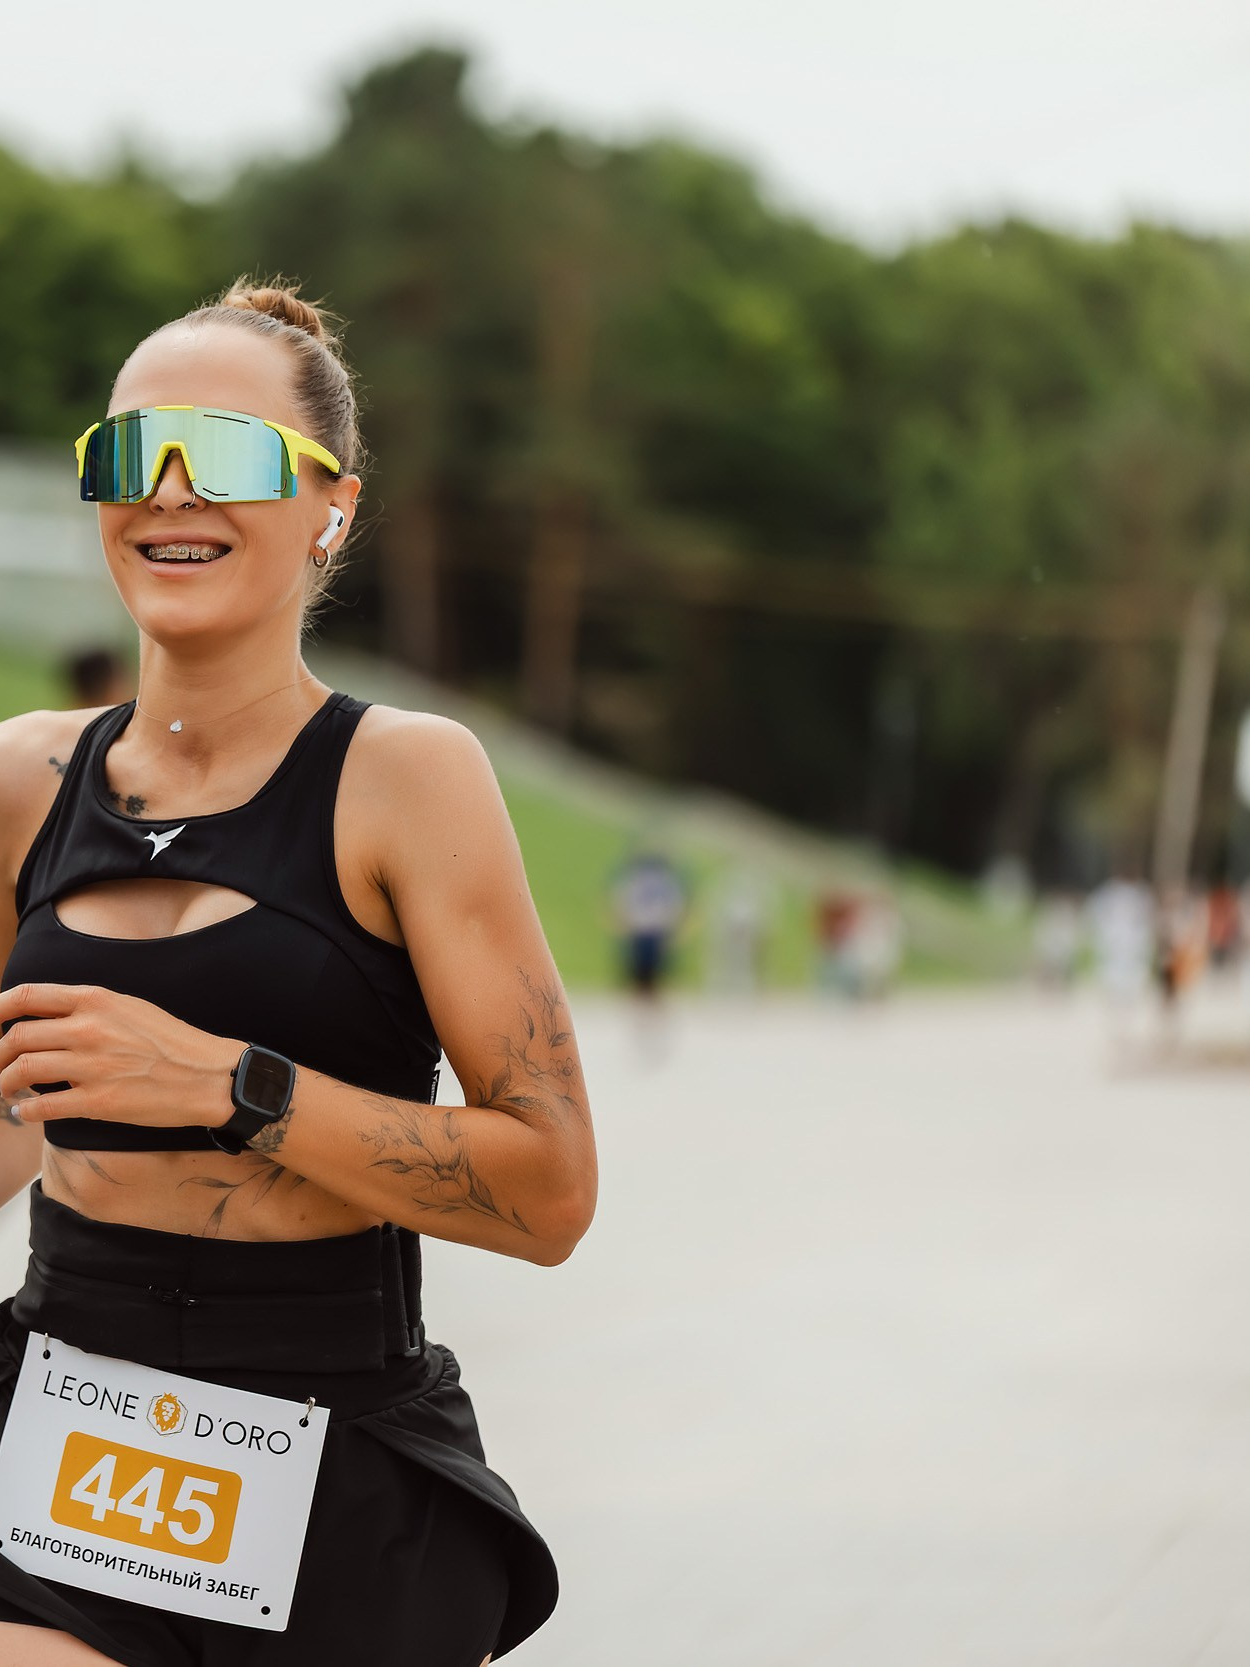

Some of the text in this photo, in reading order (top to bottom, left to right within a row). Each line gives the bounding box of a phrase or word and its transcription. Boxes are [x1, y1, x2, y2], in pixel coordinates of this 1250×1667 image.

[43, 1371, 291, 1454] LEONE D'ORO
[70, 1453, 219, 1546] 445
[10, 1527, 260, 1601] БЛАГОТВОРИТЕЛЬНЫЙ ЗАБЕГ
